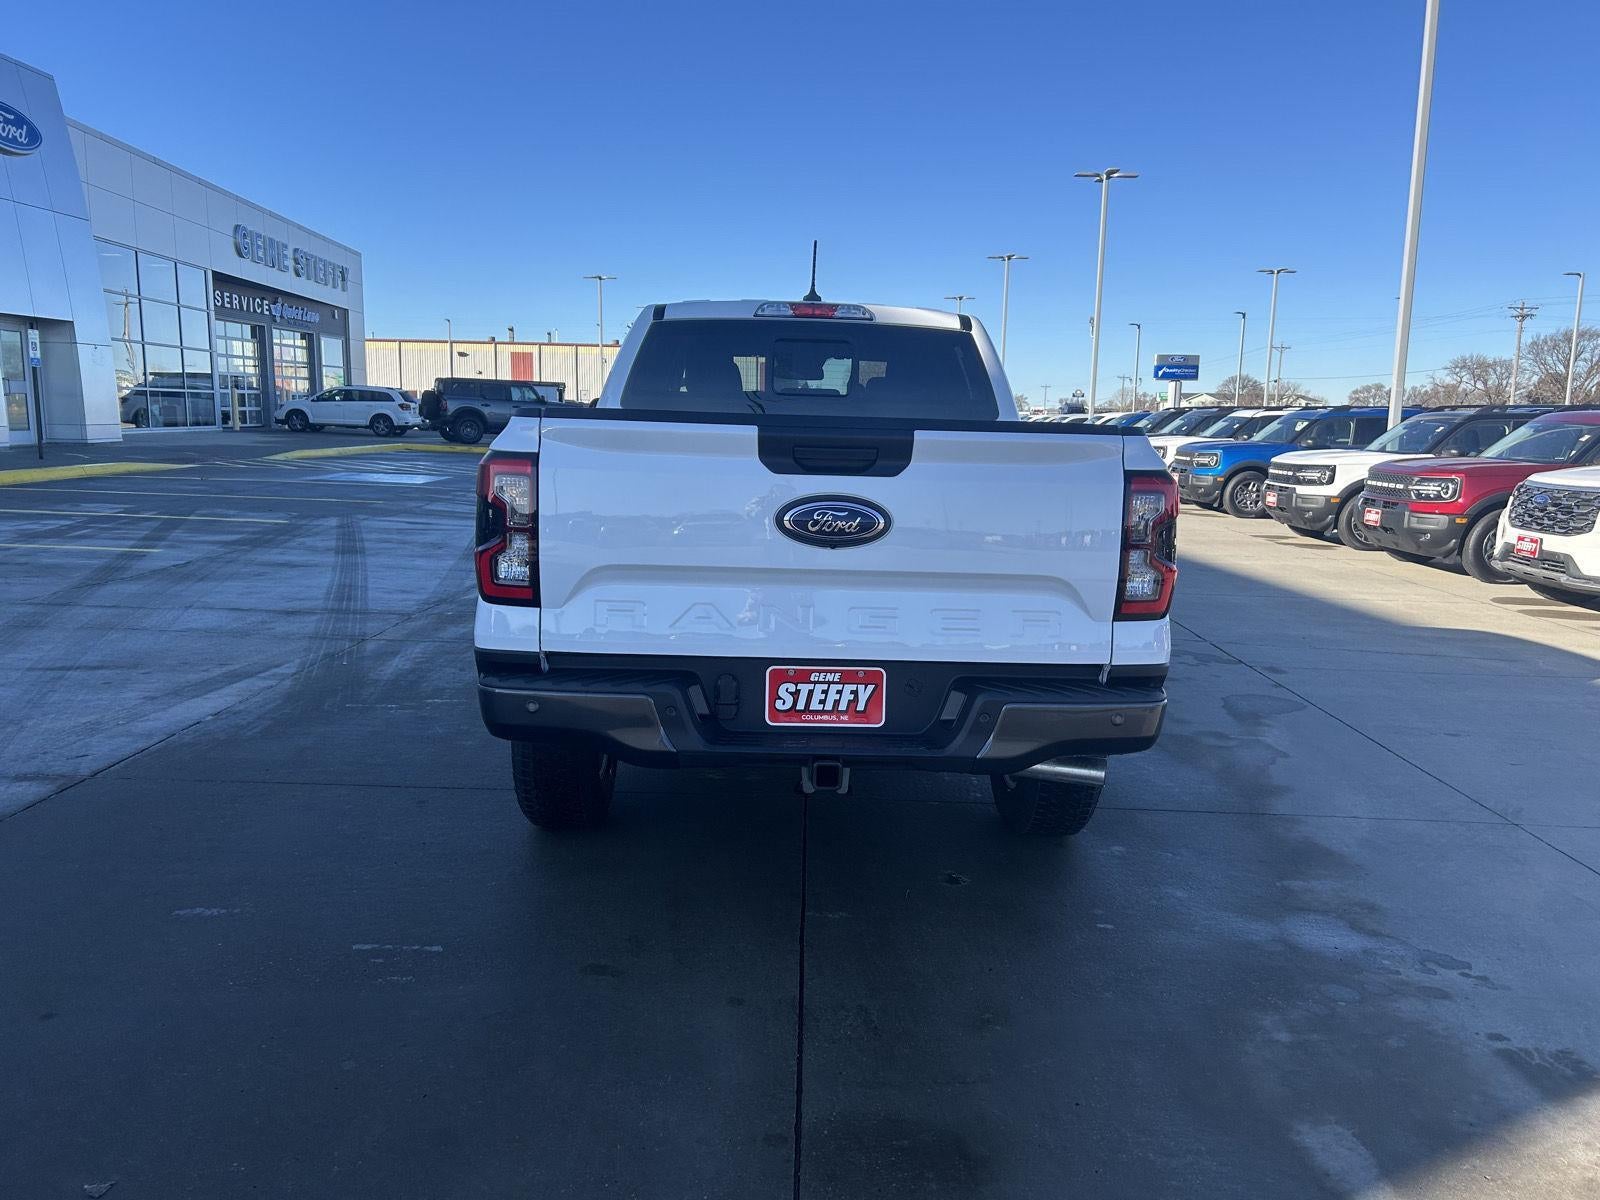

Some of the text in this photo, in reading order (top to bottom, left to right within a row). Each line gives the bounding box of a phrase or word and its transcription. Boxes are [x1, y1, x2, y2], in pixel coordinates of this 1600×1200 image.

[233, 223, 350, 292] GENE STEFFY
[214, 290, 270, 315] SERVICE
[282, 303, 303, 320] Quick
[807, 509, 862, 533] Ford
[593, 599, 1062, 638] RANGER
[810, 672, 842, 682] GENE
[774, 682, 877, 711] STEFFY
